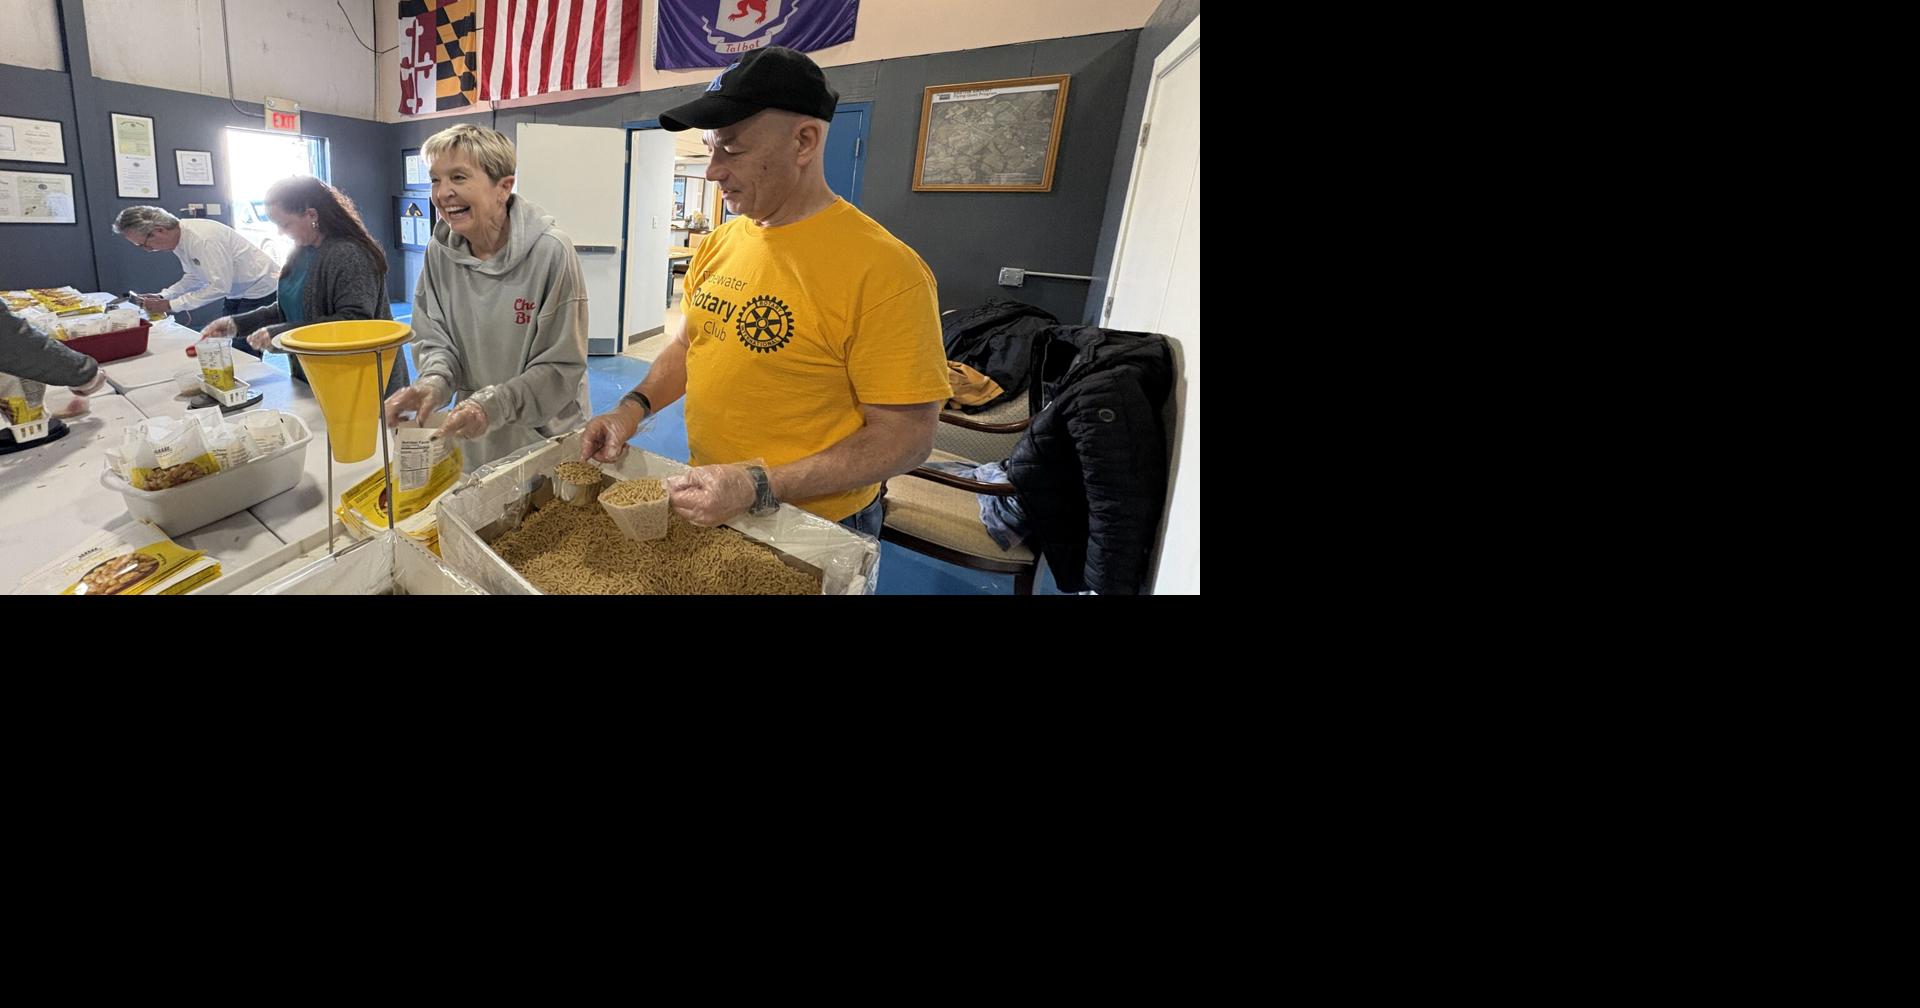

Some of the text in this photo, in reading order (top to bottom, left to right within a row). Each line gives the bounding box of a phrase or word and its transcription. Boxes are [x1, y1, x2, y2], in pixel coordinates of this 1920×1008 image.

[726, 40, 760, 53] Talbot
[273, 111, 296, 129] EXIT
[702, 270, 748, 292] Tdewater
[759, 300, 783, 313] ROTARY
[703, 320, 727, 341] Club
[740, 324, 780, 346] INTERNATIONAL
